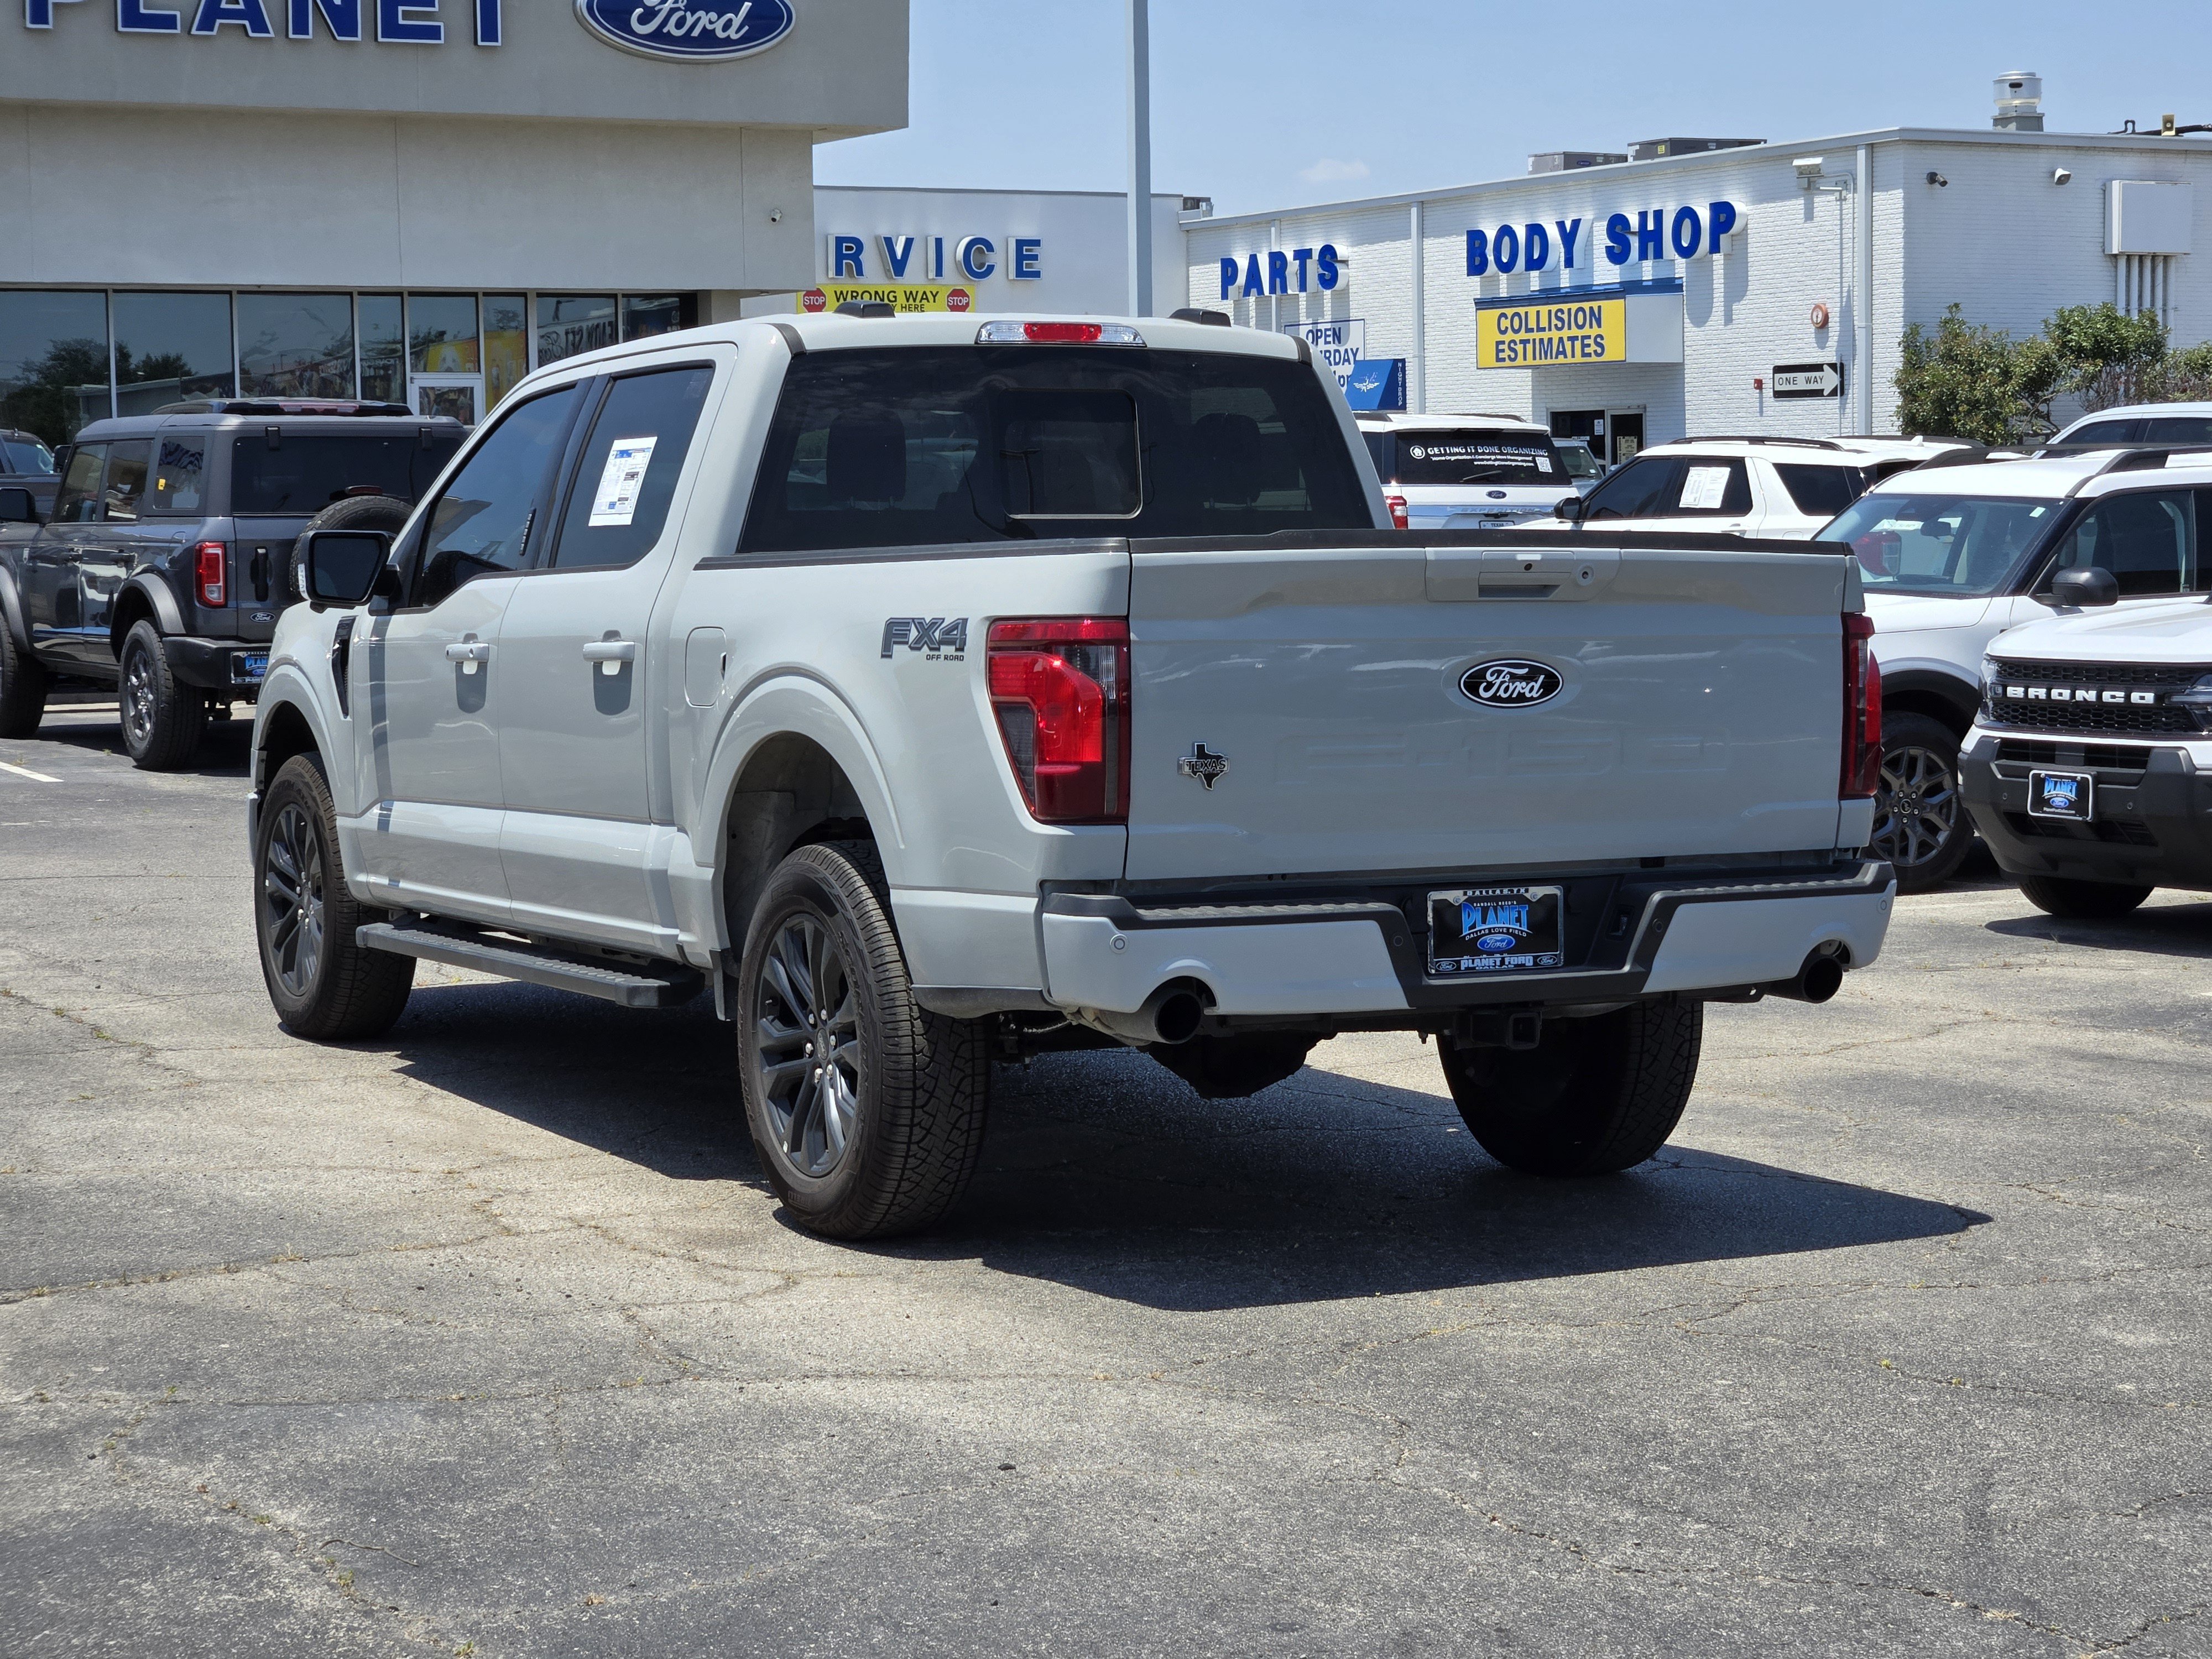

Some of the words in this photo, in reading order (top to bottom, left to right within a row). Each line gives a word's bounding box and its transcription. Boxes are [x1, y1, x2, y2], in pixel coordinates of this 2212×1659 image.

[630, 0, 752, 40] Ford
[1465, 218, 1582, 276] BODY
[1605, 201, 1736, 265] SHOP
[1220, 244, 1339, 300] PARTS
[804, 296, 826, 305] STOP
[834, 290, 897, 302] WRONG
[905, 290, 939, 303] WAY
[948, 296, 969, 305] STOP
[901, 304, 925, 312] HERE
[1496, 305, 1602, 335] COLLISION
[1306, 327, 1342, 346] OPEN
[1319, 347, 1359, 367] RDAY
[1495, 334, 1605, 363] ESTIMATES
[1778, 377, 1798, 386] ONE
[1804, 375, 1824, 384] WAY
[1427, 446, 1465, 455] GETTING
[1502, 446, 1548, 456] ORGANIZING
[880, 617, 969, 659] FX4
[1479, 666, 1545, 698] Ford
[2006, 686, 2155, 704] BRONCO
[1185, 759, 1226, 771] TEXAS
[2043, 776, 2078, 796] PLANET
[1461, 901, 1529, 935] PLANET
[1465, 929, 1489, 940] DALLAS
[1509, 928, 1527, 937] FIELD
[1460, 957, 1503, 971] PLANET
[1505, 956, 1533, 967] FORD
